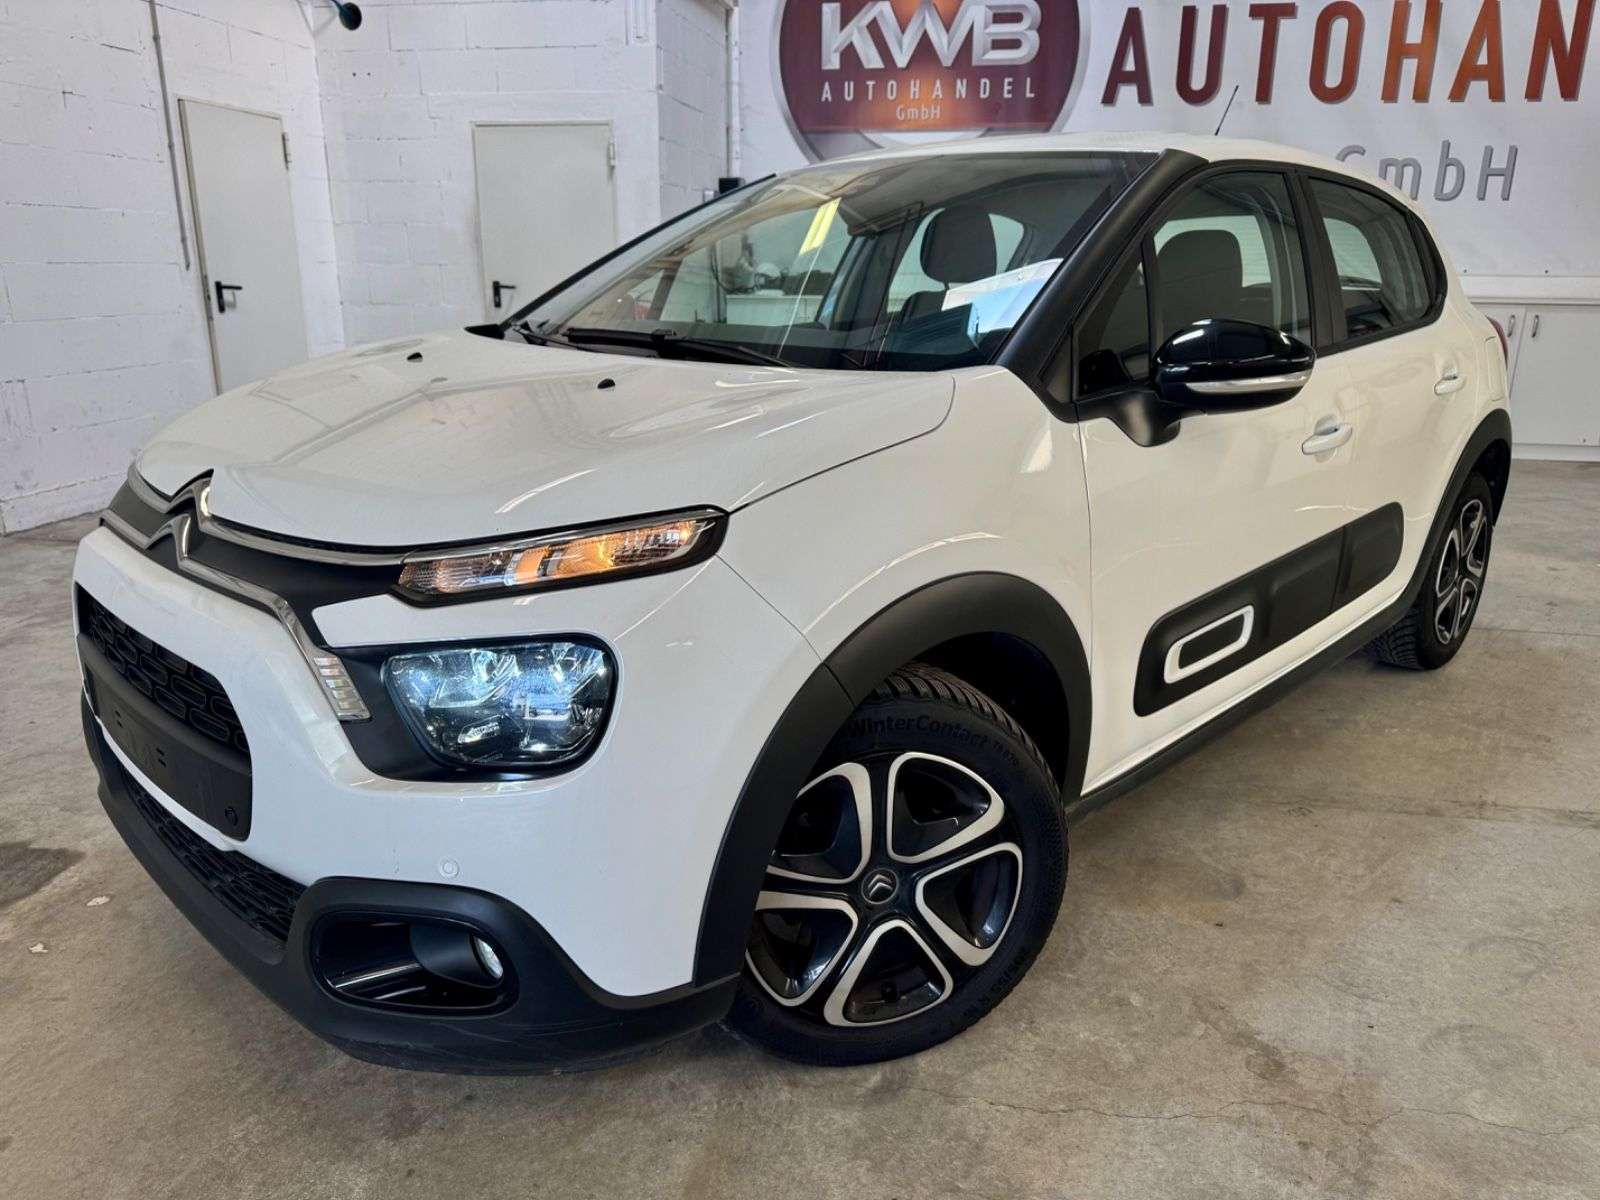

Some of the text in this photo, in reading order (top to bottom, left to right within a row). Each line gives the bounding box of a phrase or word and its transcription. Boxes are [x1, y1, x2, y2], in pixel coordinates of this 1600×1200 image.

[821, 0, 1042, 70] KWB
[1101, 0, 1598, 107] AUTOHAN
[821, 77, 1036, 103] AUTOHANDEL
[896, 104, 941, 121] GmbH
